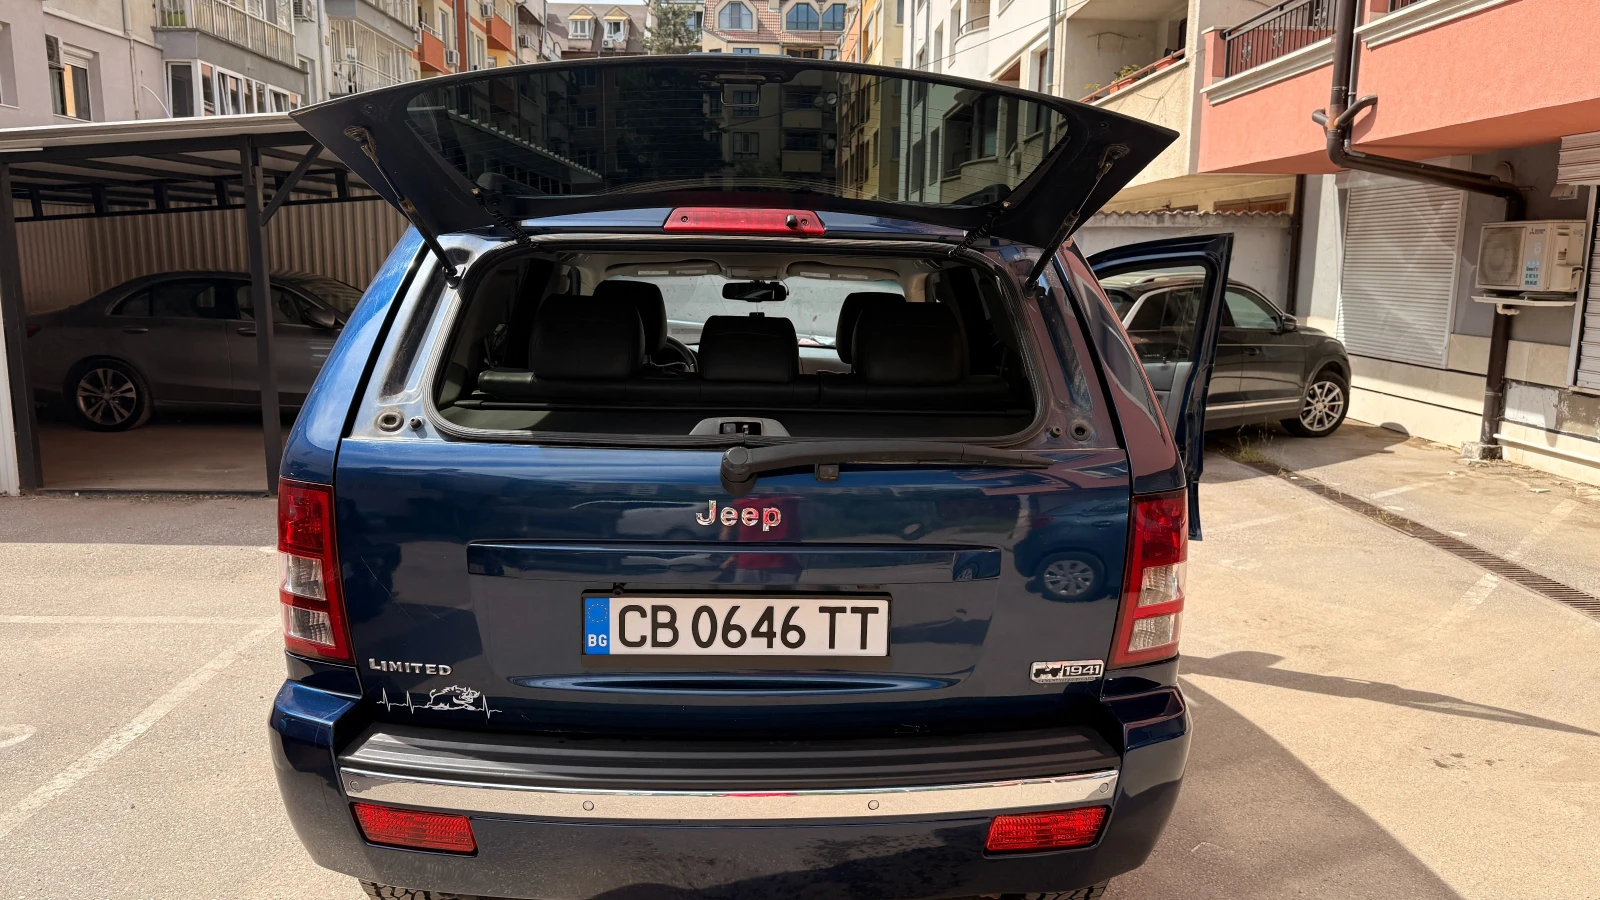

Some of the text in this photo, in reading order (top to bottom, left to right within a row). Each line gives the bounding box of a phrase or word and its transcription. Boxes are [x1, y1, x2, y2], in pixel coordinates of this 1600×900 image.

[695, 499, 781, 531] Jeep
[618, 604, 880, 650] CB 0646 TT
[587, 634, 608, 647] BG
[368, 658, 452, 675] LIMITED
[1064, 665, 1100, 676] 1941
